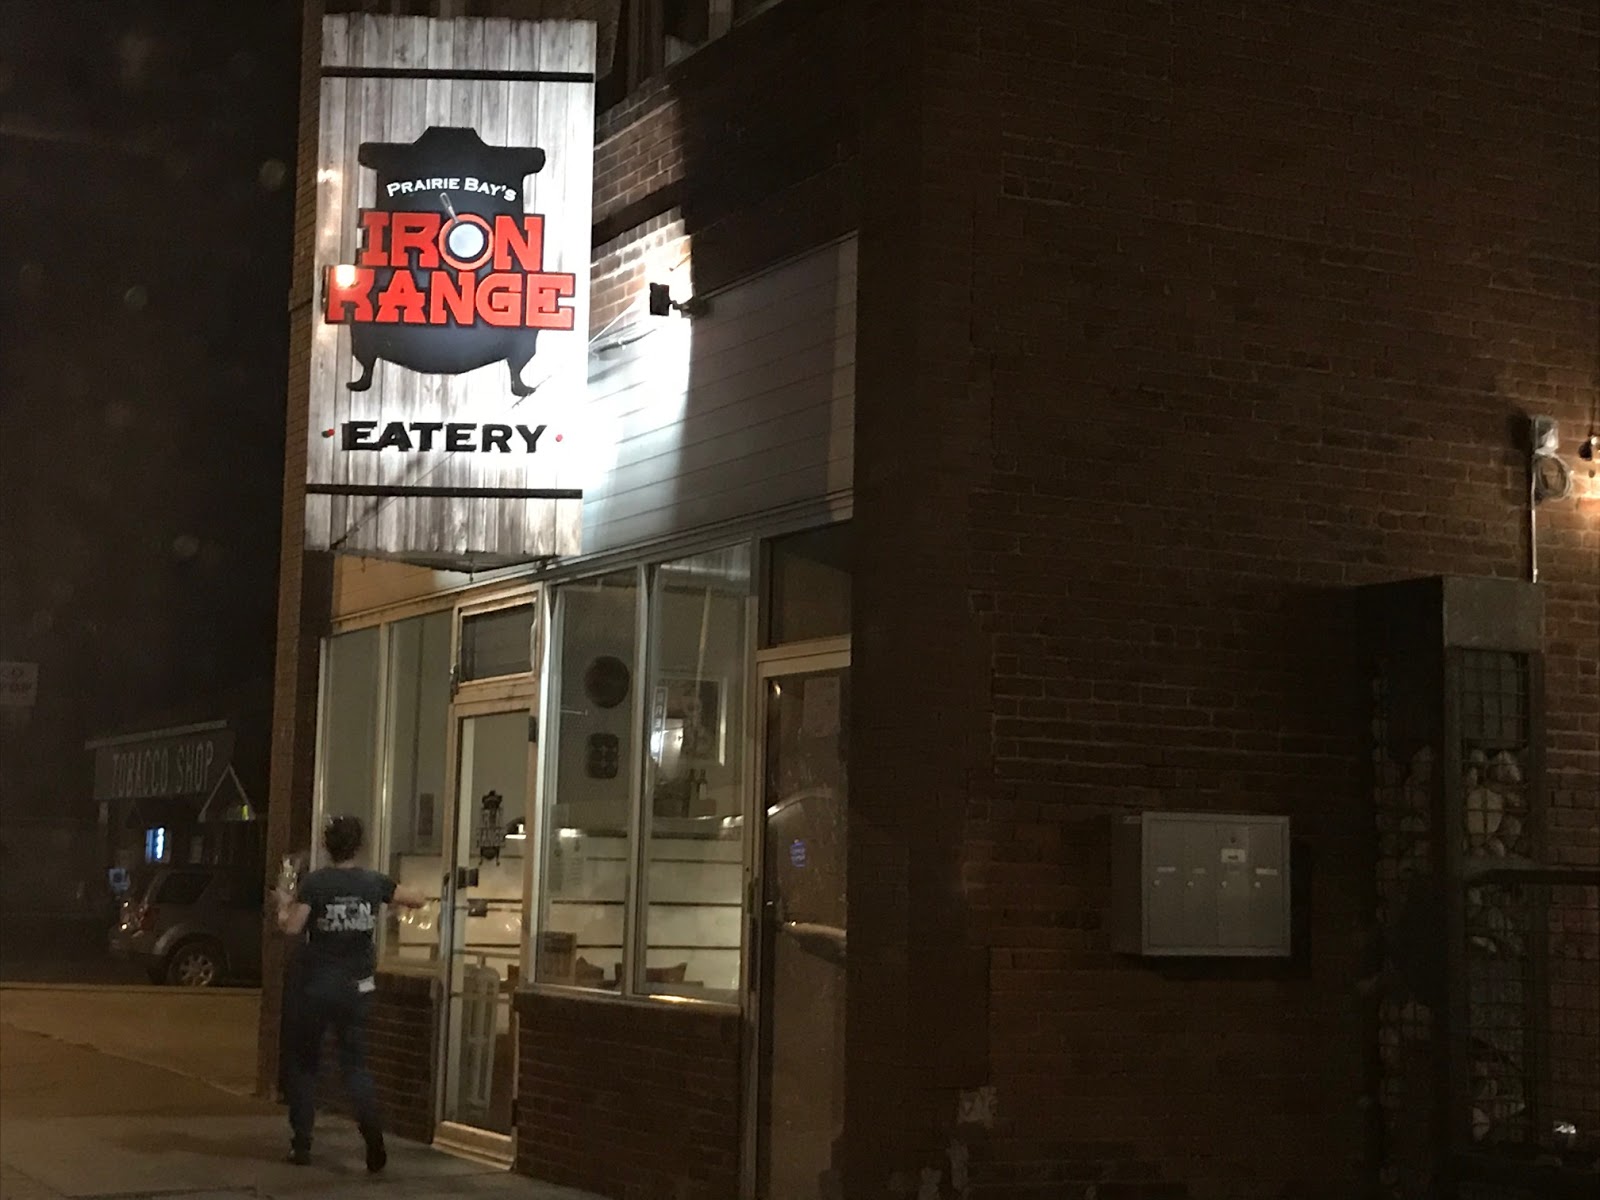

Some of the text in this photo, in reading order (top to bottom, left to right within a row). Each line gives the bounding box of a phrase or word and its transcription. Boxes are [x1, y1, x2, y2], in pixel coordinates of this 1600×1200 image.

[386, 177, 517, 202] PRAIRIE BAY'S
[359, 211, 544, 272] IRON
[327, 266, 575, 329] RANGE
[342, 421, 547, 453] EATERY
[112, 740, 214, 797] TOBACCO SHOP
